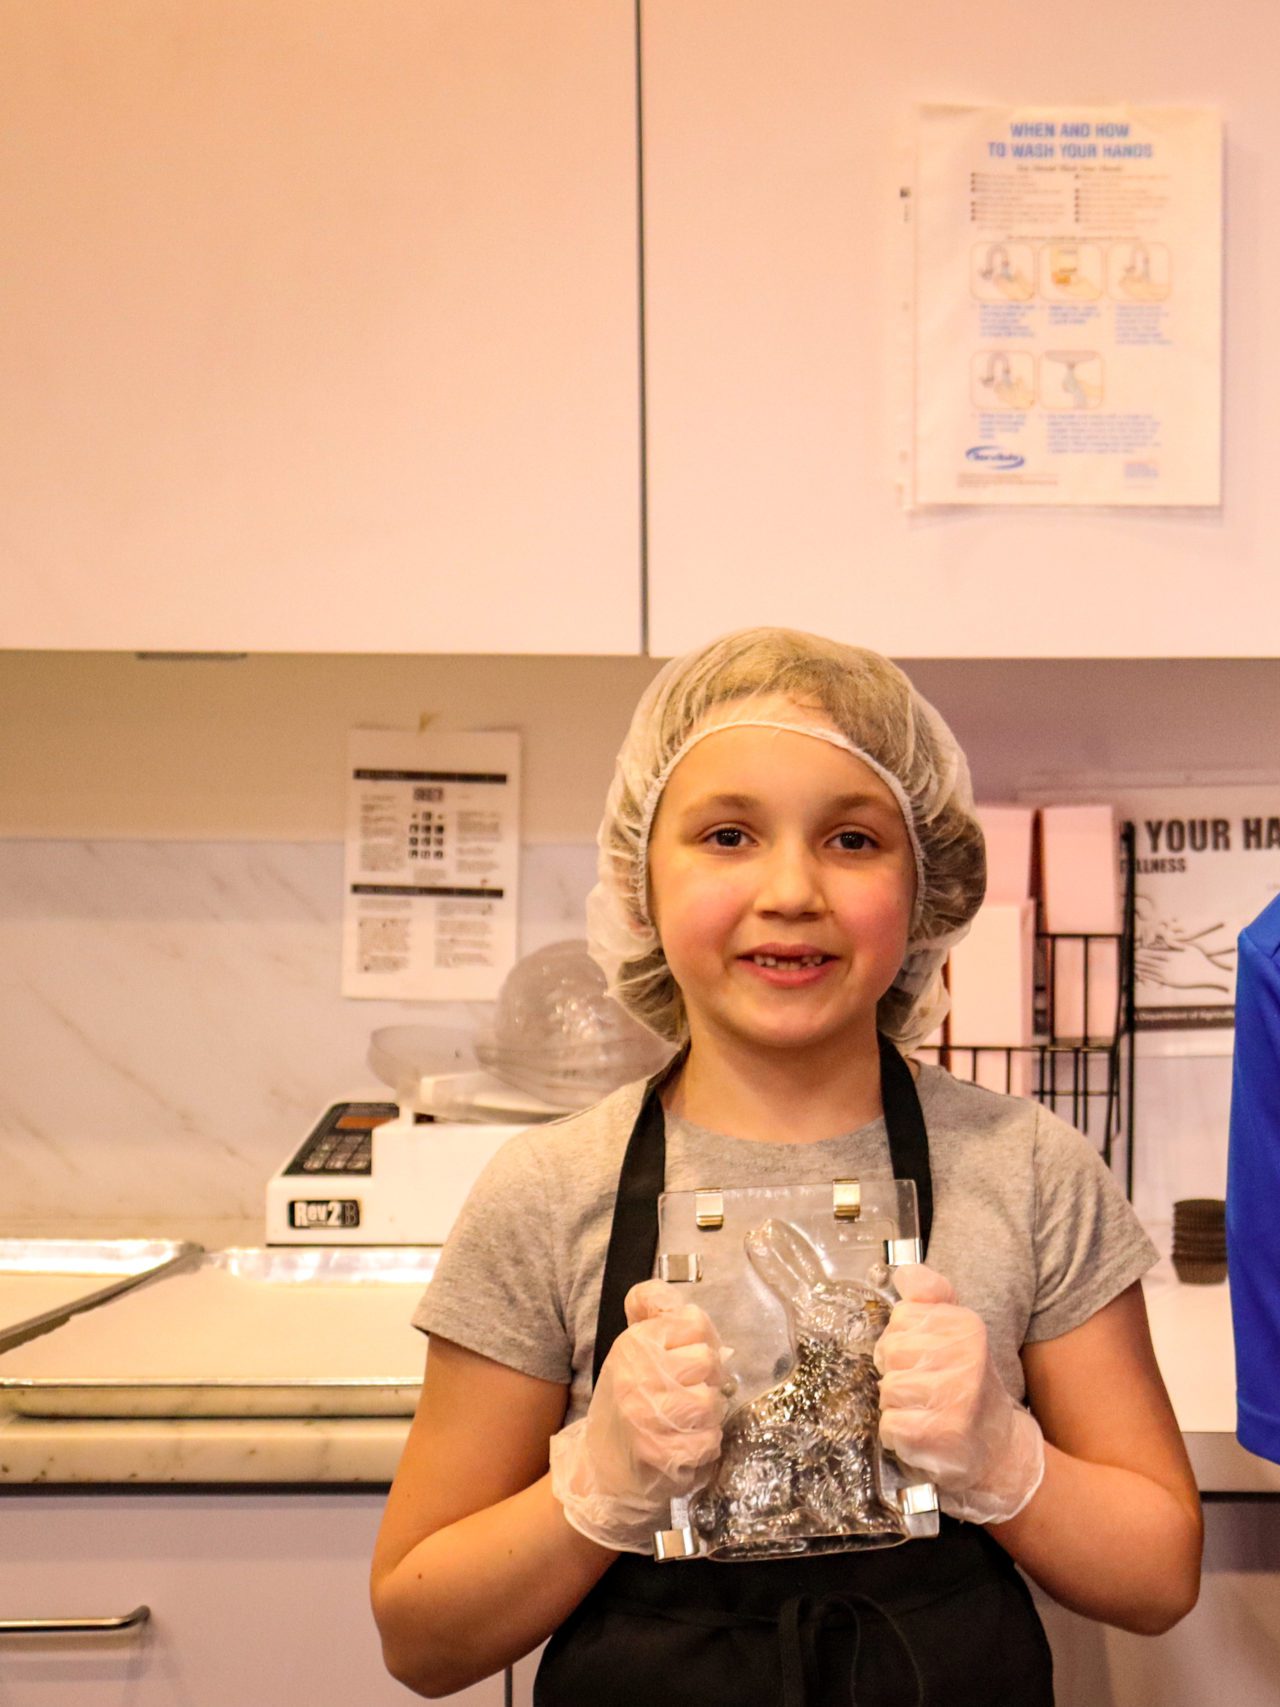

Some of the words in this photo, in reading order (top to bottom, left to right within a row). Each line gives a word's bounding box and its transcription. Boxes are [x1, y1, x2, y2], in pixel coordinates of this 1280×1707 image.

[1010, 122, 1055, 137] WHEN
[1061, 122, 1091, 137] AND
[1096, 122, 1130, 137] HOW
[988, 142, 1006, 157] TO
[1011, 143, 1054, 158] WASH
[1060, 143, 1097, 158] YOUR
[1103, 143, 1153, 158] HANDS
[1145, 817, 1231, 852] YOUR
